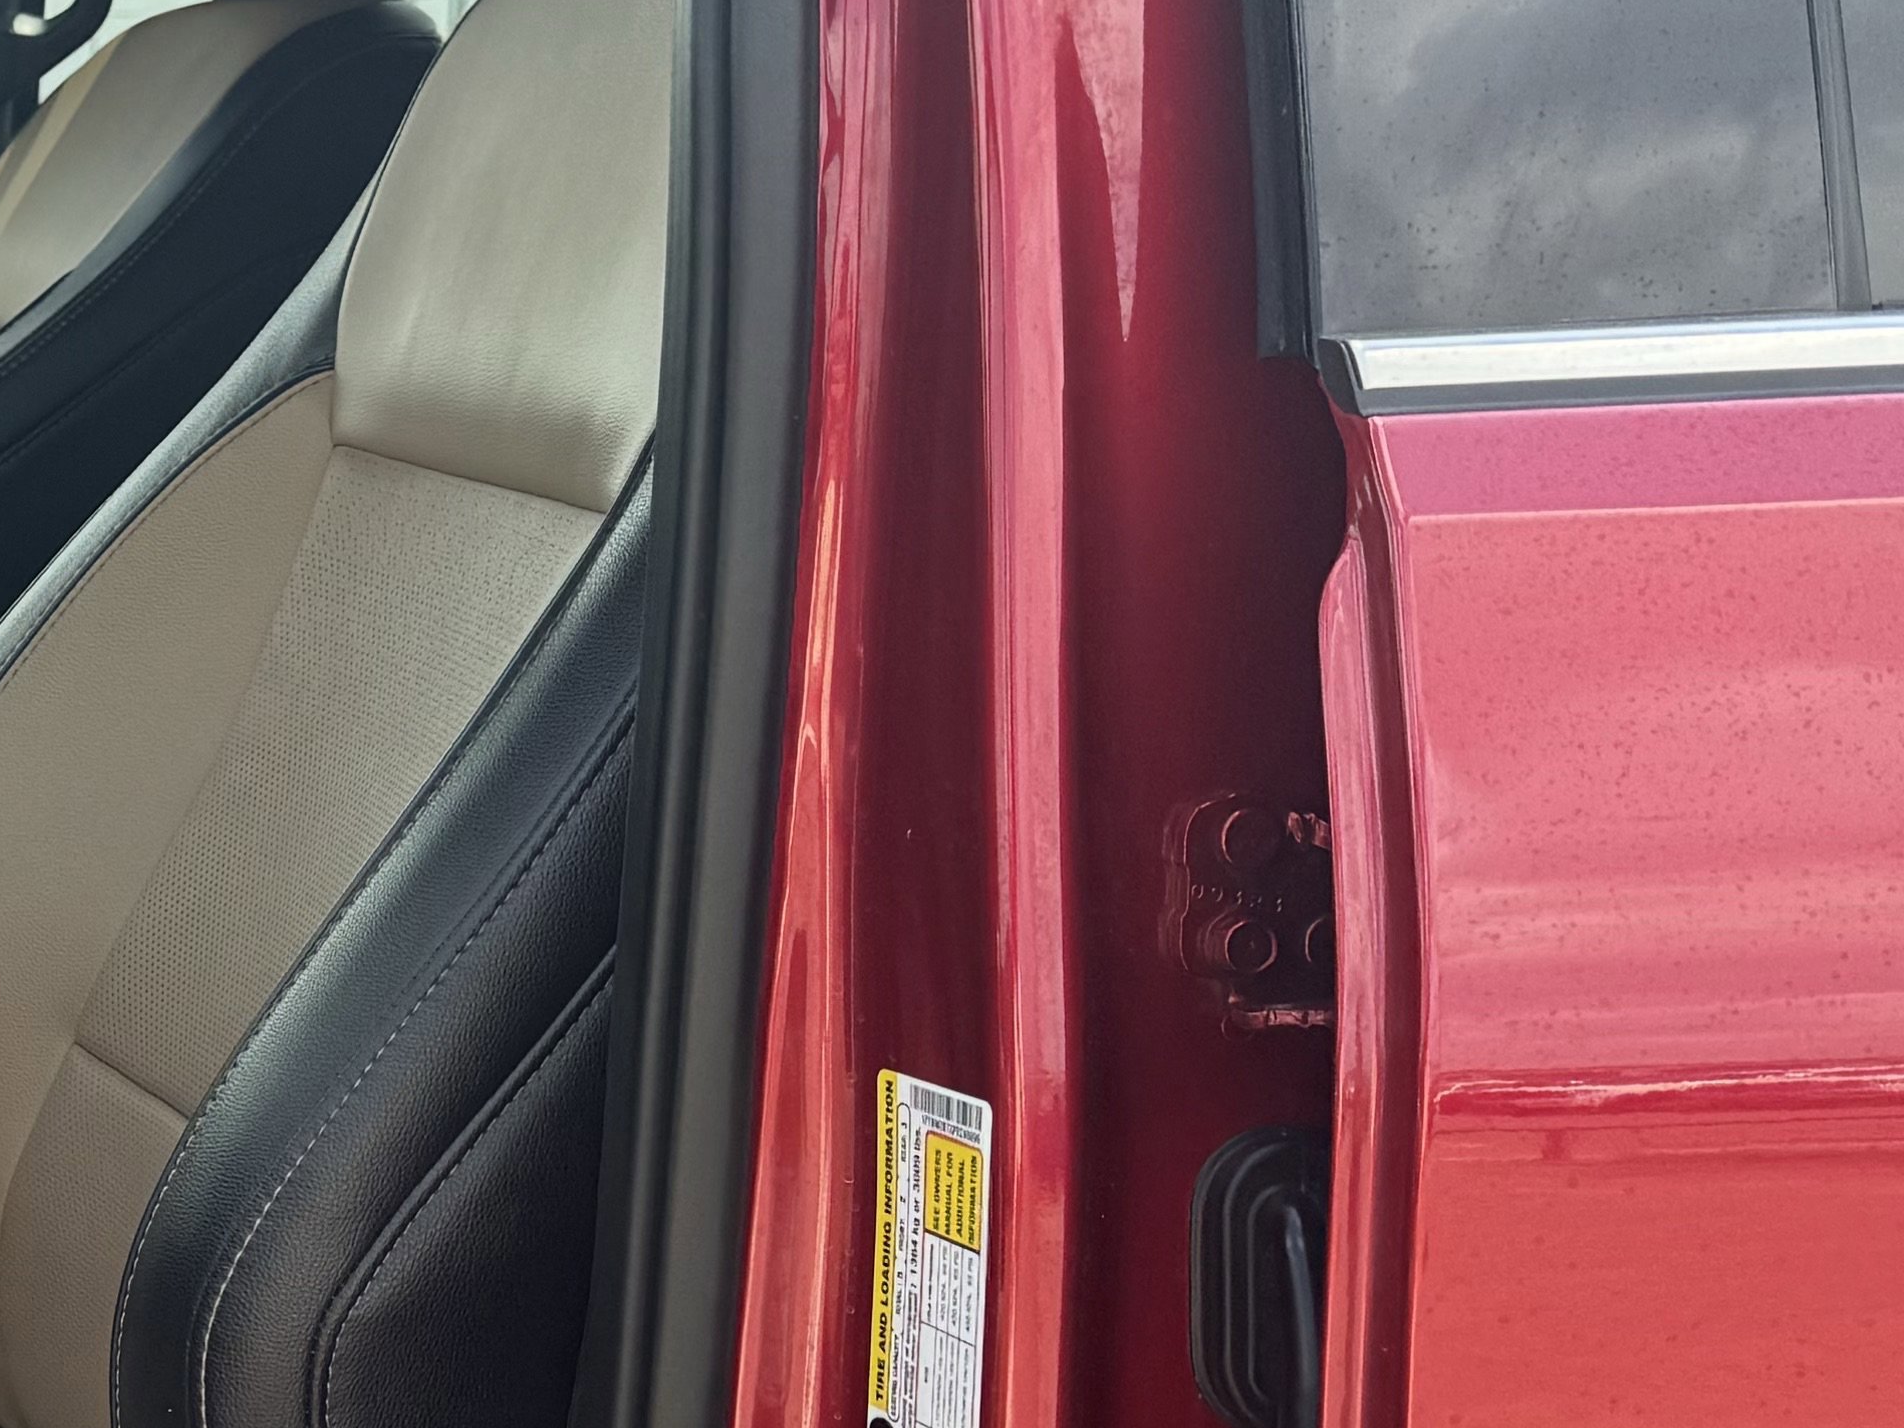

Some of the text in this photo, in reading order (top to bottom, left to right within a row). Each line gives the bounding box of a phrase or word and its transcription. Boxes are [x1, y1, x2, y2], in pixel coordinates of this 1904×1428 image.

[875, 1079, 895, 1402] TIRE AND LOADING INFORMATION
